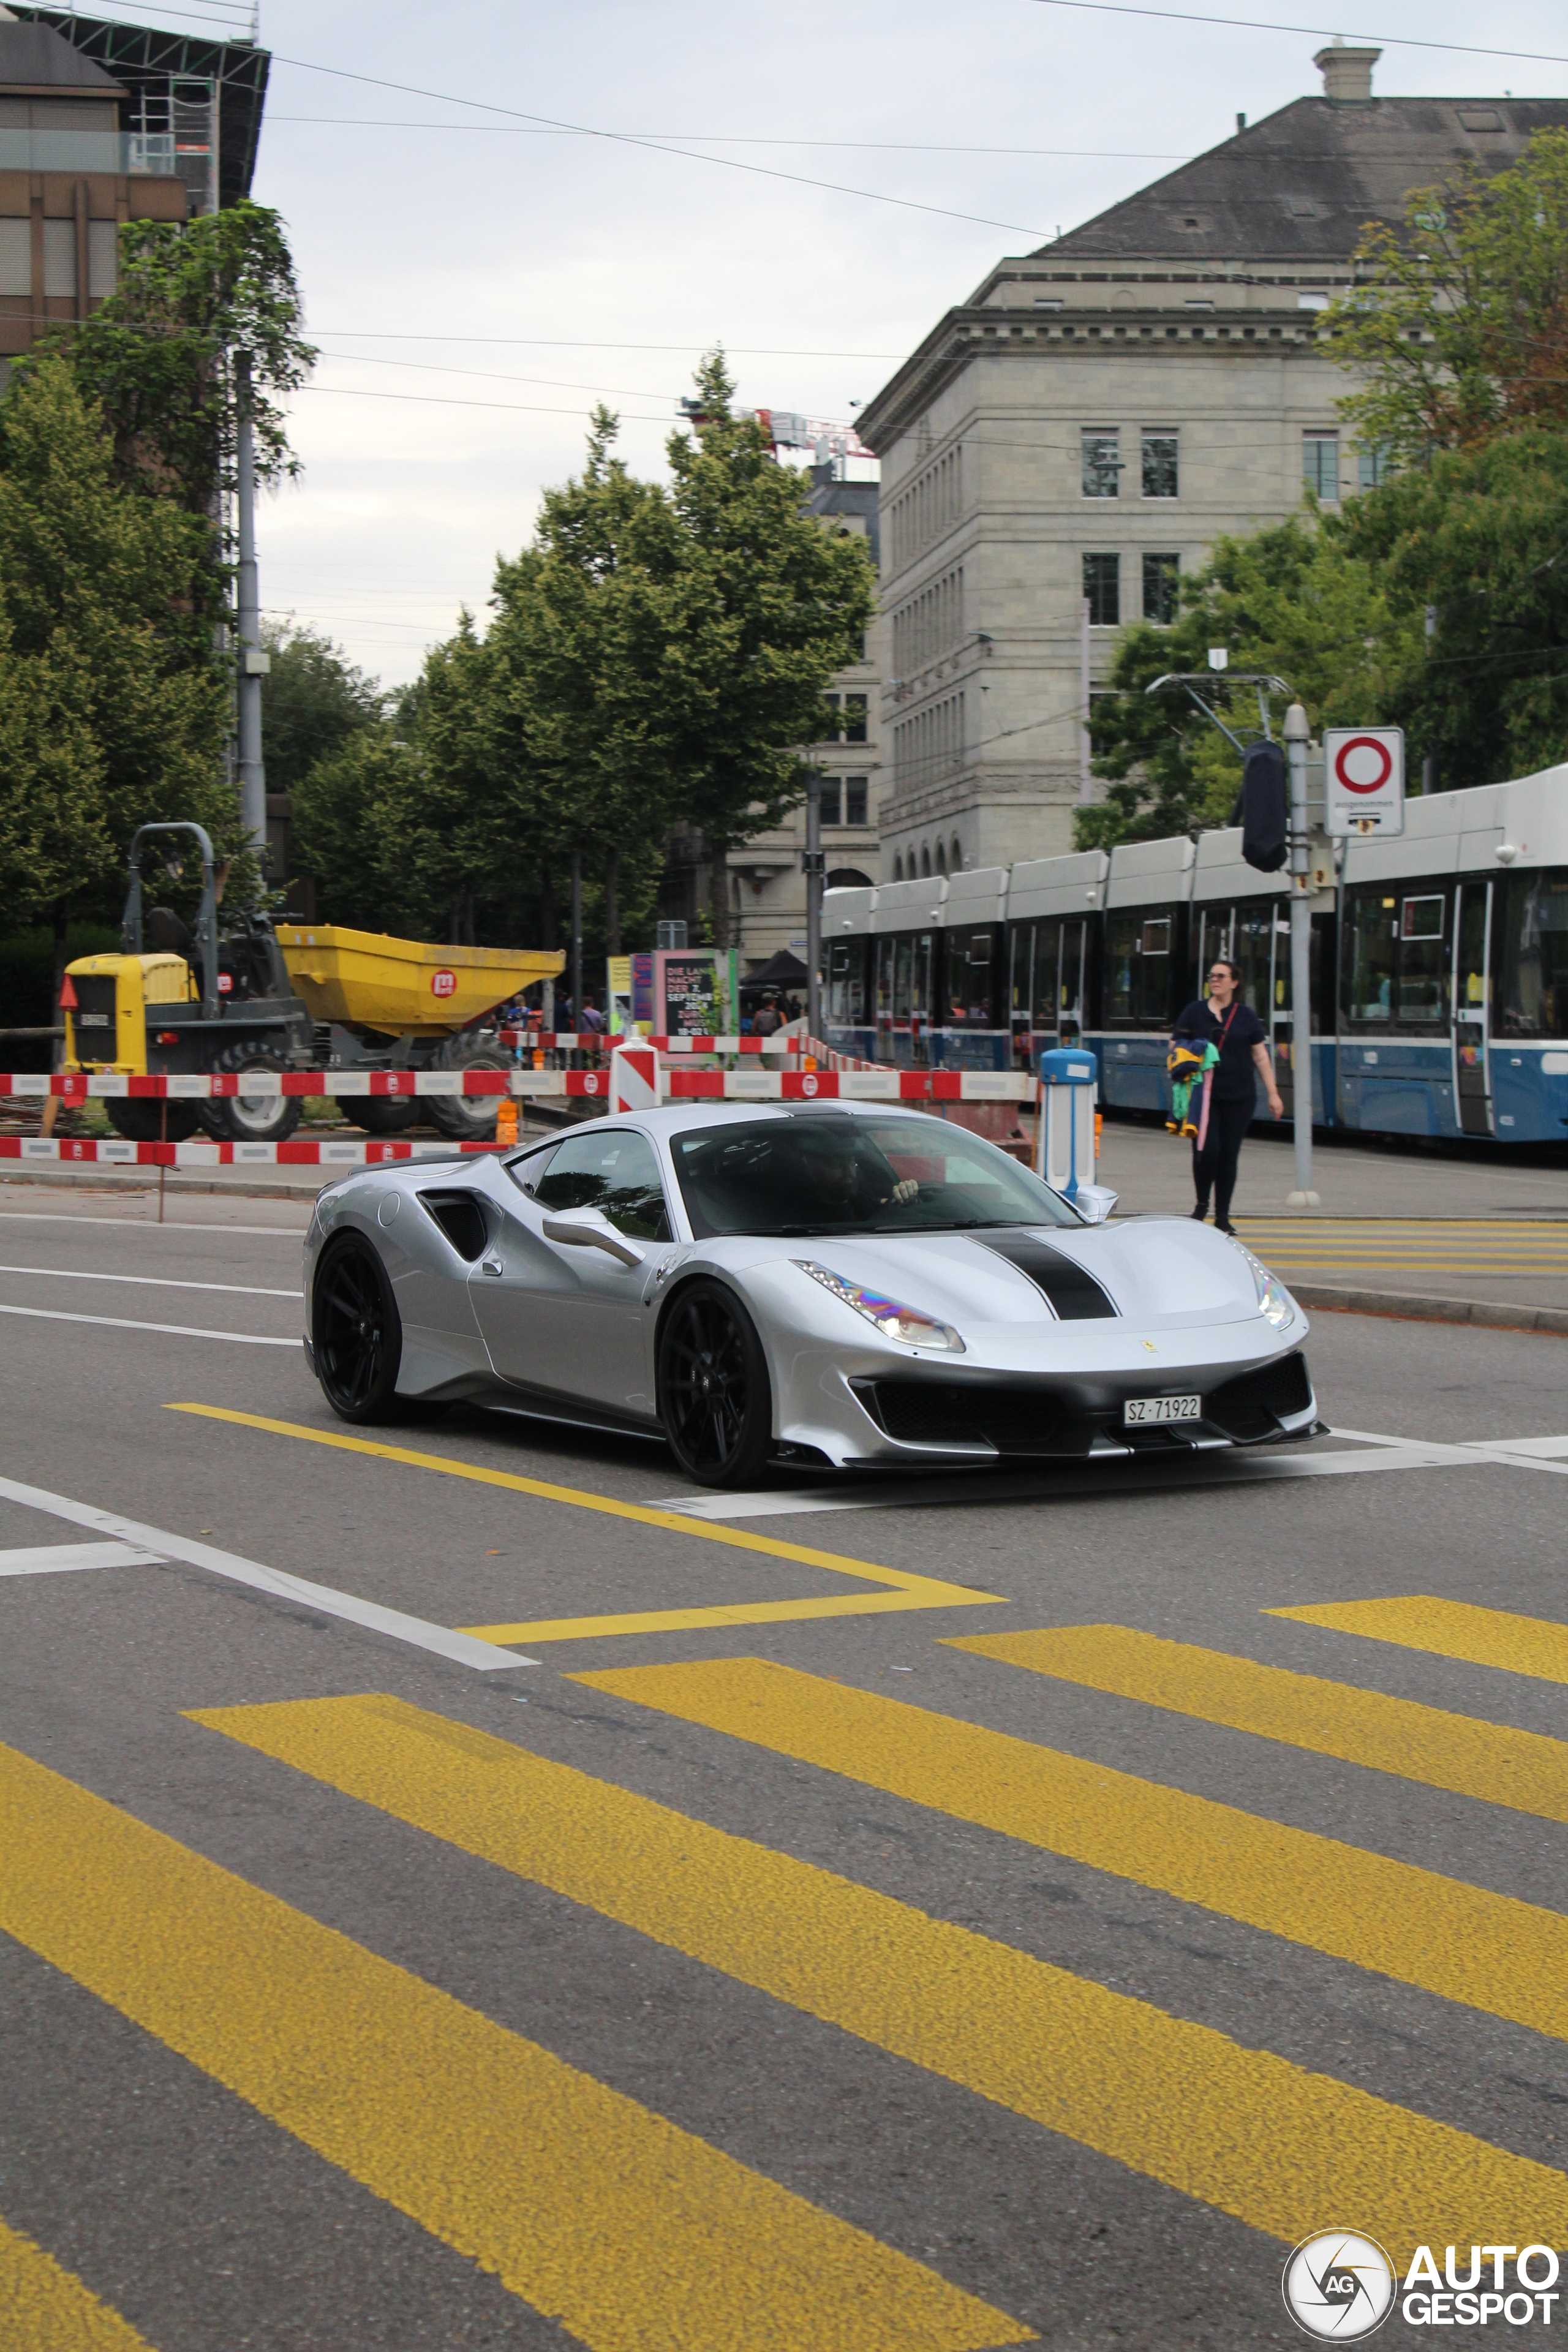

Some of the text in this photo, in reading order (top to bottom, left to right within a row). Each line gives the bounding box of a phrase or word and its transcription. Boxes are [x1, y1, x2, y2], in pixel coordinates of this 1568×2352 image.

[667, 967, 684, 976] DIE
[667, 976, 702, 984] NACHT
[667, 984, 688, 993] DER
